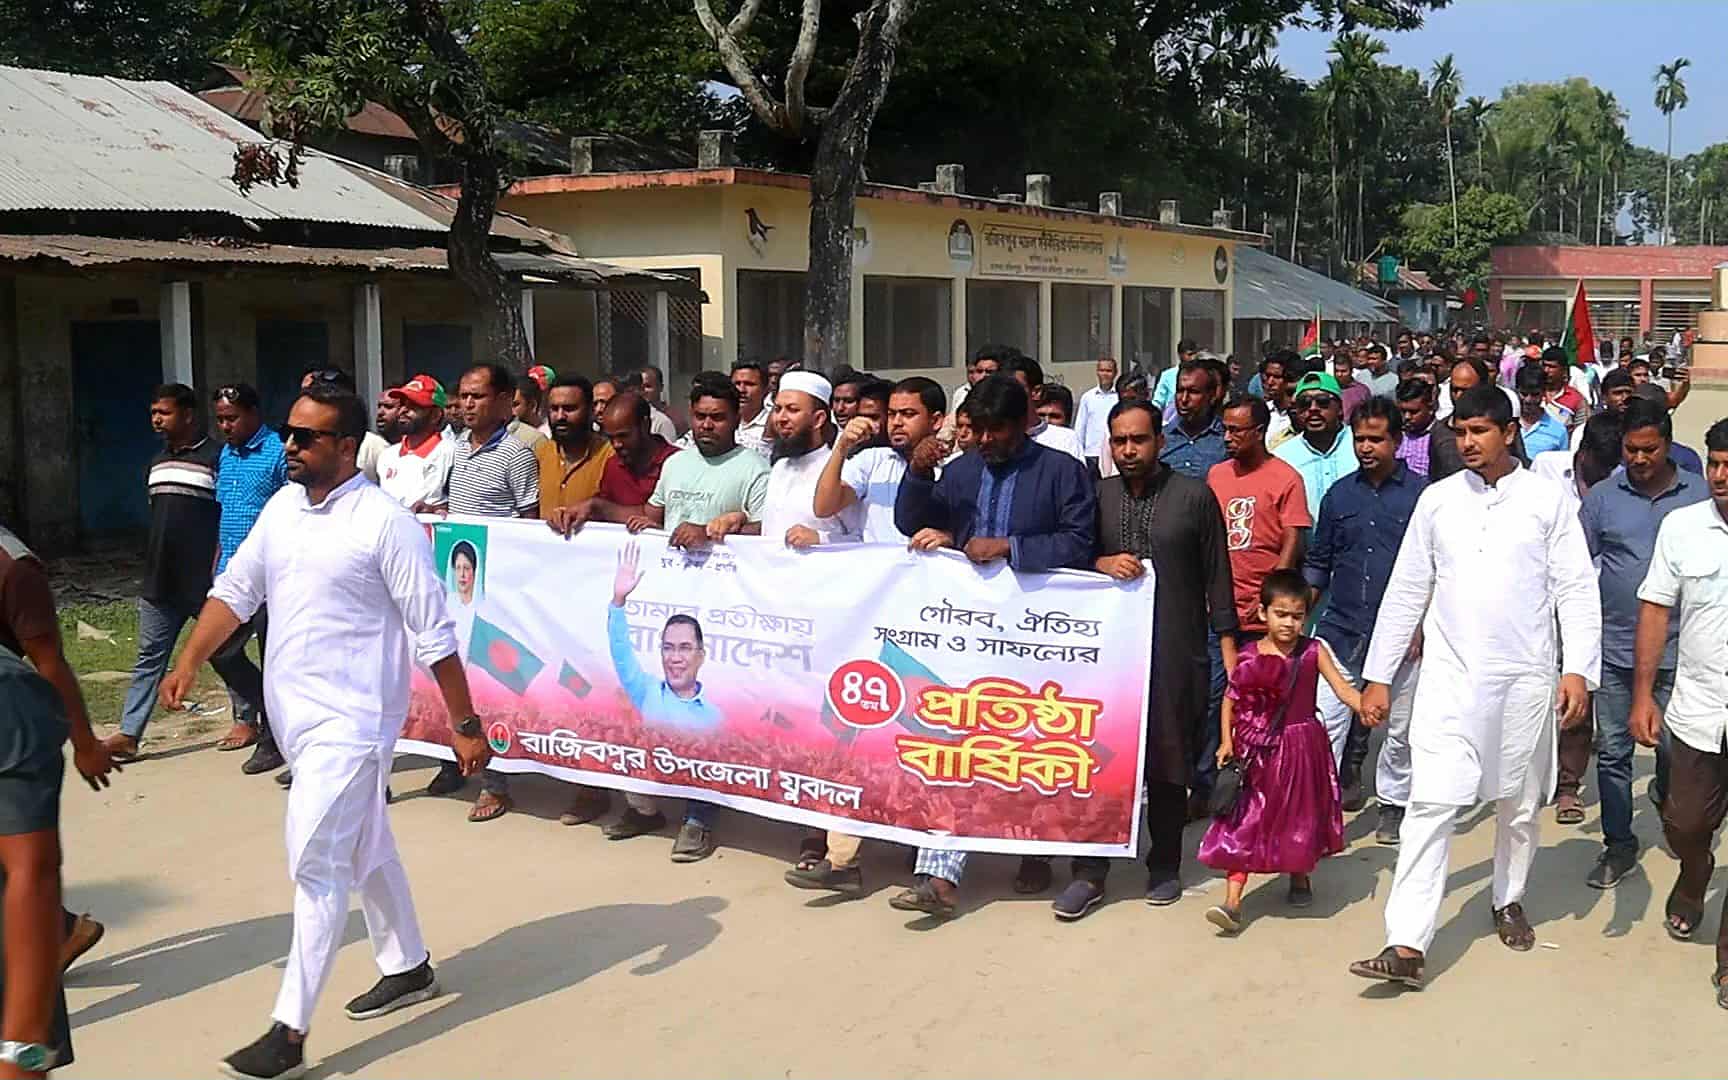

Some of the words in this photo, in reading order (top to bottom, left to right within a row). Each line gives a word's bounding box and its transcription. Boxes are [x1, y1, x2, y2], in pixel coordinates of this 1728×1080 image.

[920, 598, 1005, 633] গৌরব,
[1016, 607, 1102, 637] ঐতিহ্য
[873, 625, 941, 650] সংগ্রাম
[946, 635, 967, 652] ও
[976, 637, 1100, 664] সাফল্যের
[841, 671, 890, 712] ৪৭
[918, 679, 1100, 739] প্রতিষ্ঠা
[518, 729, 646, 773] রাজিবপুর
[653, 747, 771, 789] উপজেলা
[779, 770, 863, 809] যুবদল
[897, 734, 1095, 790] বার্ষিকী
